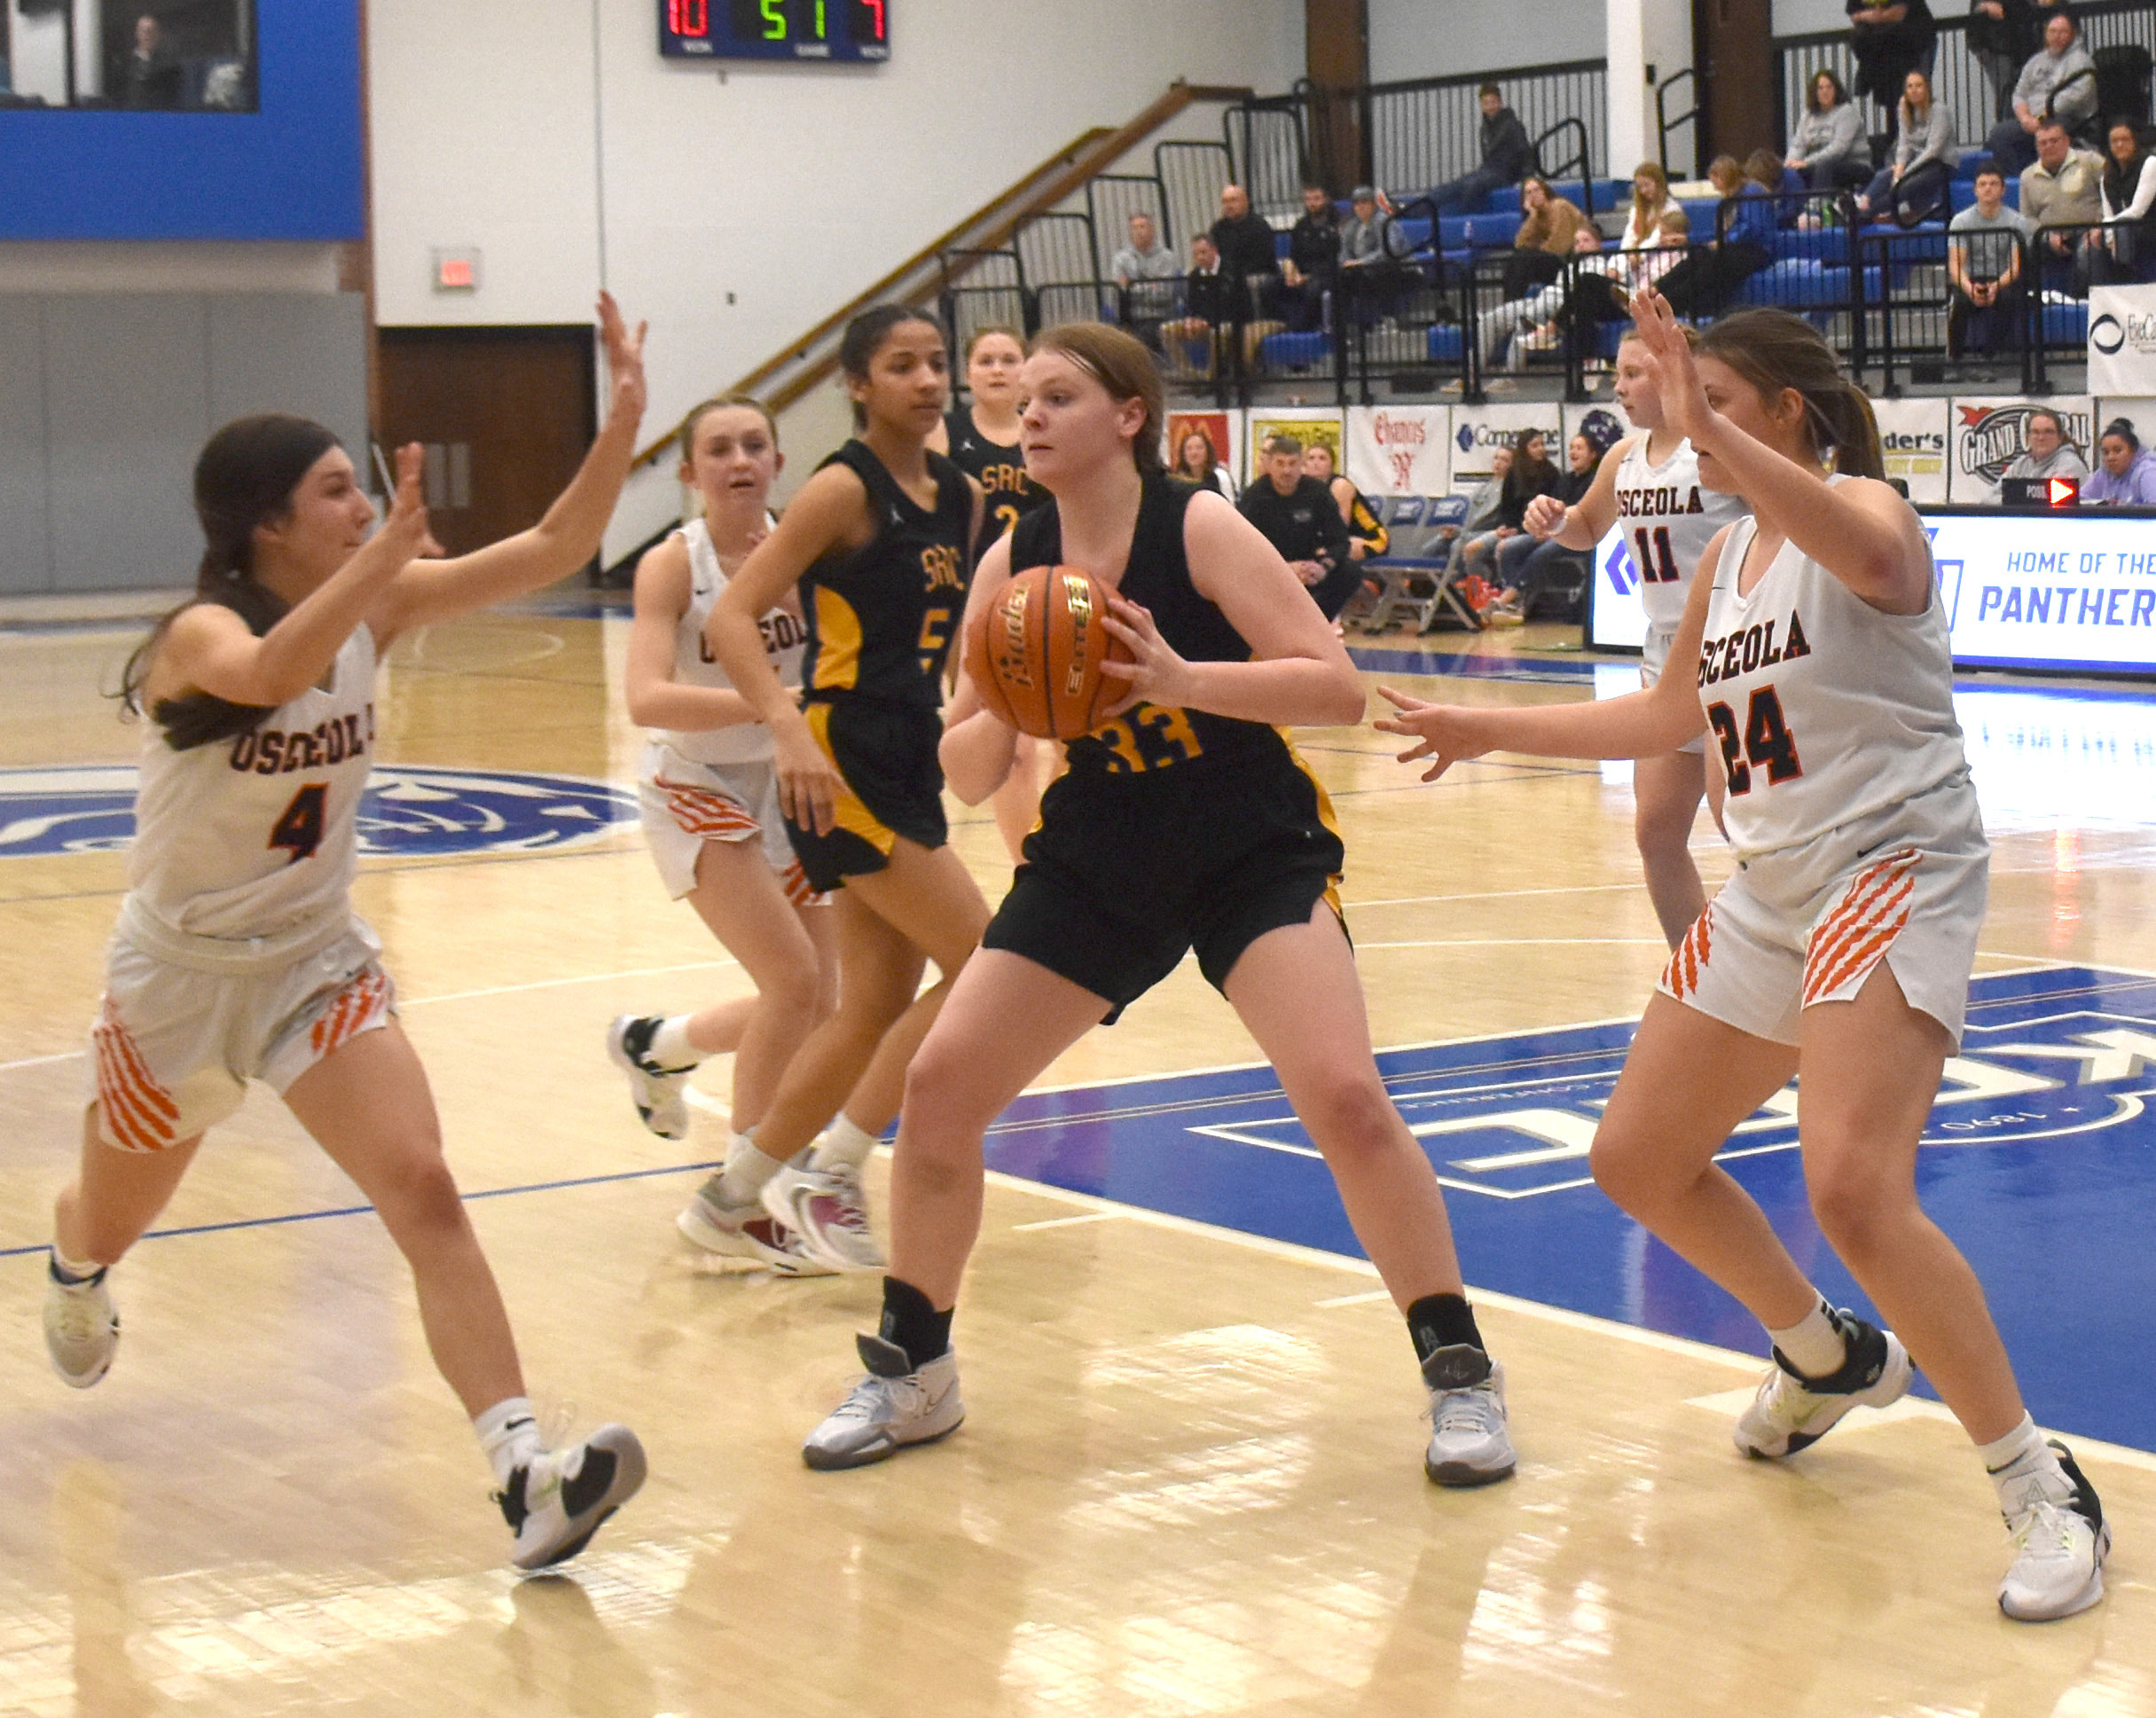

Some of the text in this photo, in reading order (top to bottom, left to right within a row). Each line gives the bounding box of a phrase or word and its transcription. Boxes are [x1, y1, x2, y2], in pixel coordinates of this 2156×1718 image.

[1883, 432, 1944, 449] der's
[1961, 423, 2016, 475] GRAND
[1618, 486, 1704, 517] SCEOLA
[1635, 527, 1679, 583] 11
[2007, 552, 2156, 575] HOME OF THE
[1697, 608, 1811, 689] SCEOLA
[1707, 684, 1803, 796] 24
[266, 781, 330, 866] 4
[1940, 1111, 2047, 1131] 1890
